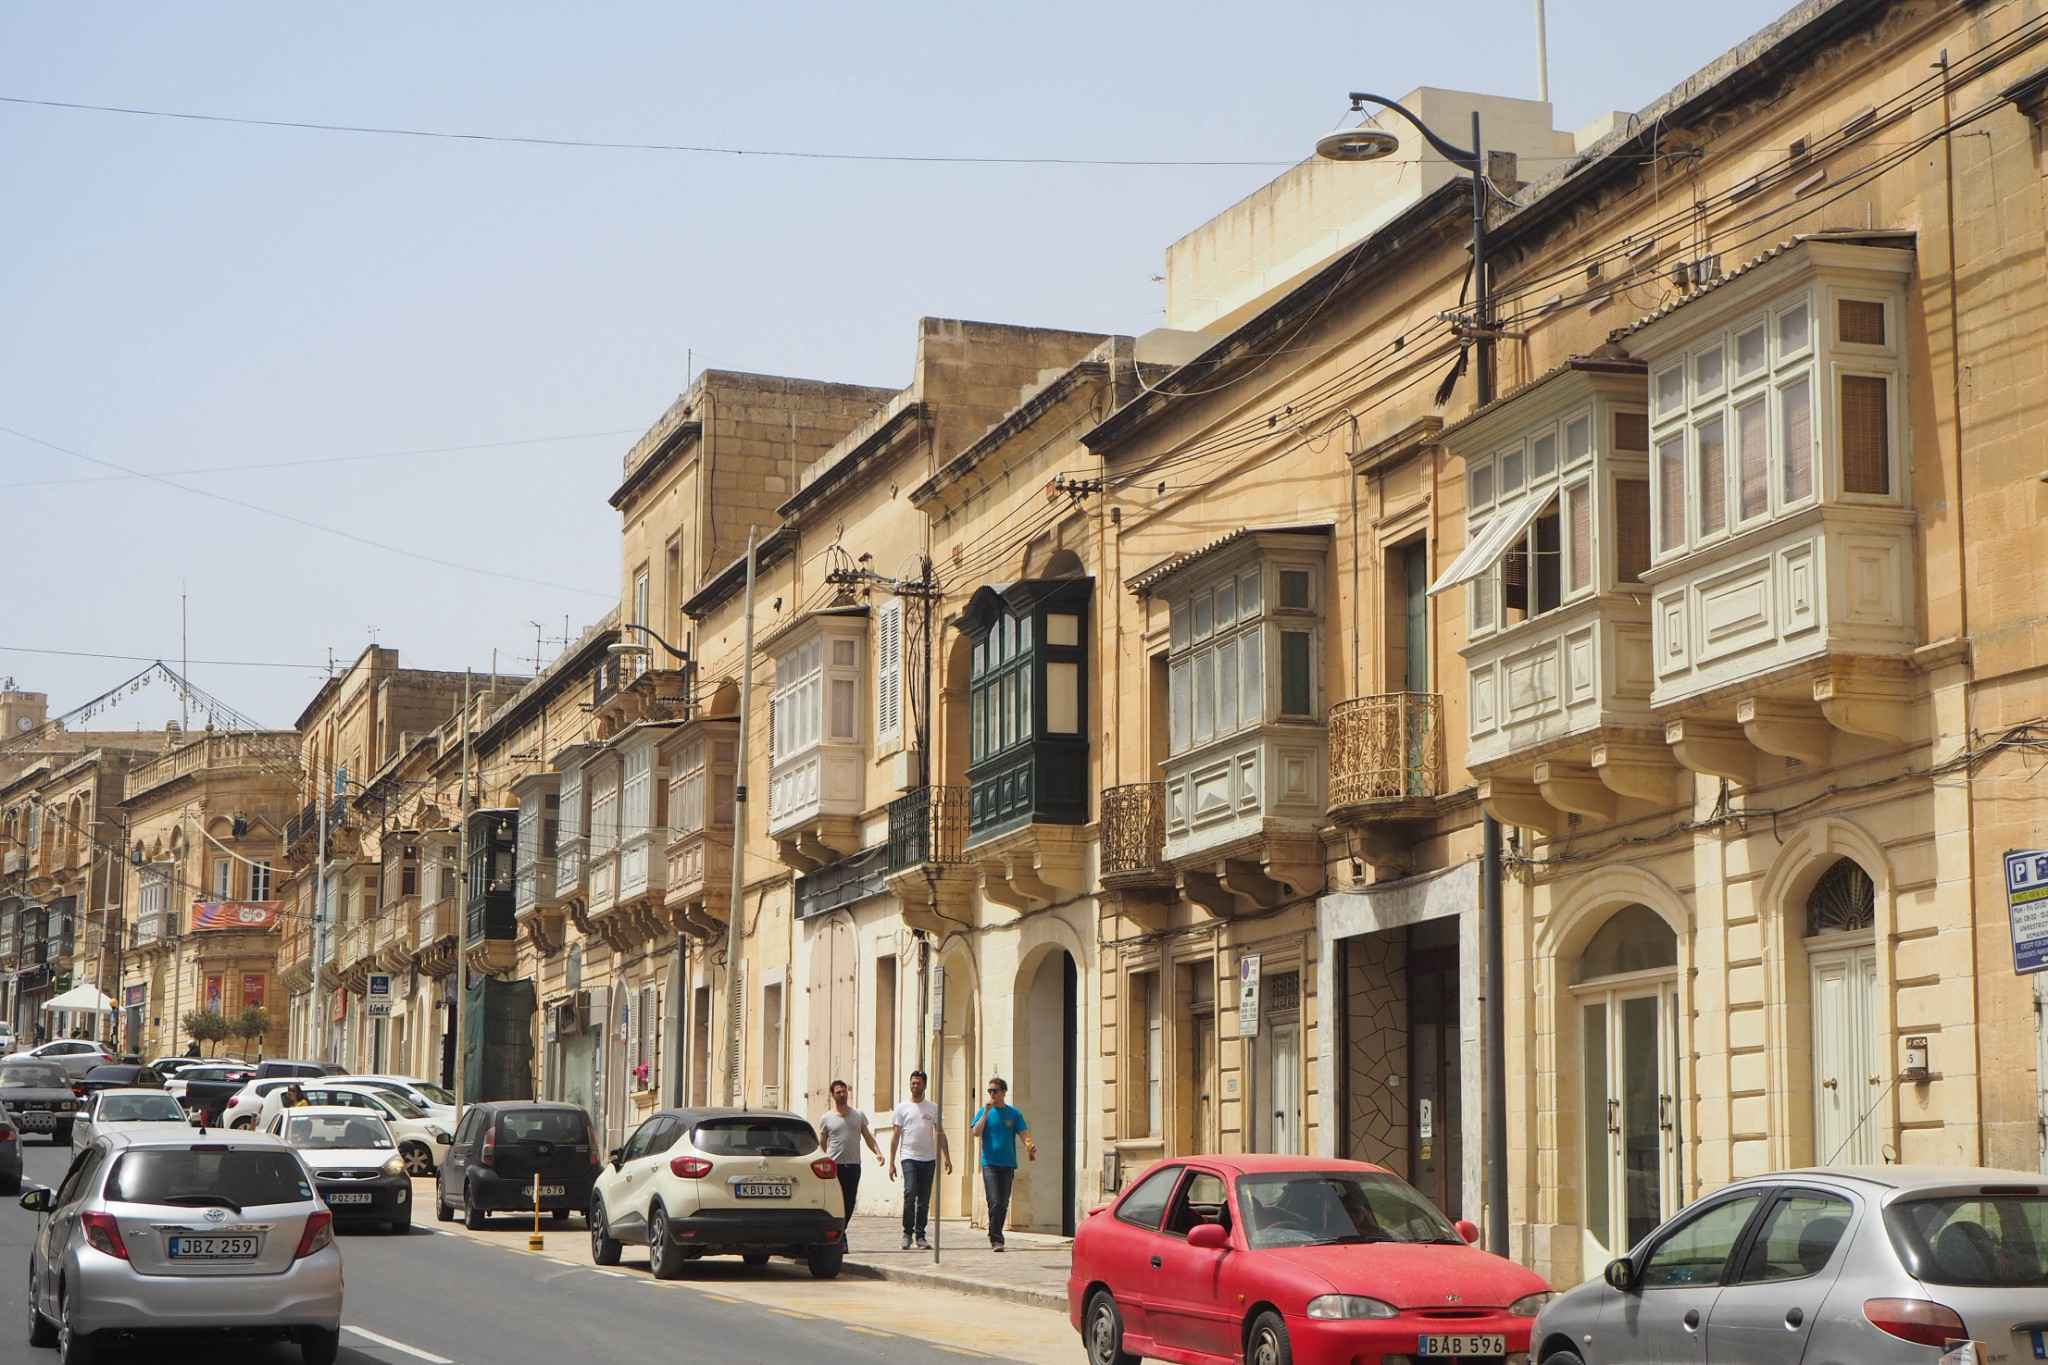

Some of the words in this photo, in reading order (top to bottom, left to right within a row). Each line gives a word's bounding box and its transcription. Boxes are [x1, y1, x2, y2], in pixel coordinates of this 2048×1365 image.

[2015, 863, 2026, 882] P
[182, 1240, 214, 1254] JBZ
[221, 1240, 252, 1254] 259
[1429, 1338, 1462, 1354] BAB
[1470, 1338, 1503, 1354] 596
